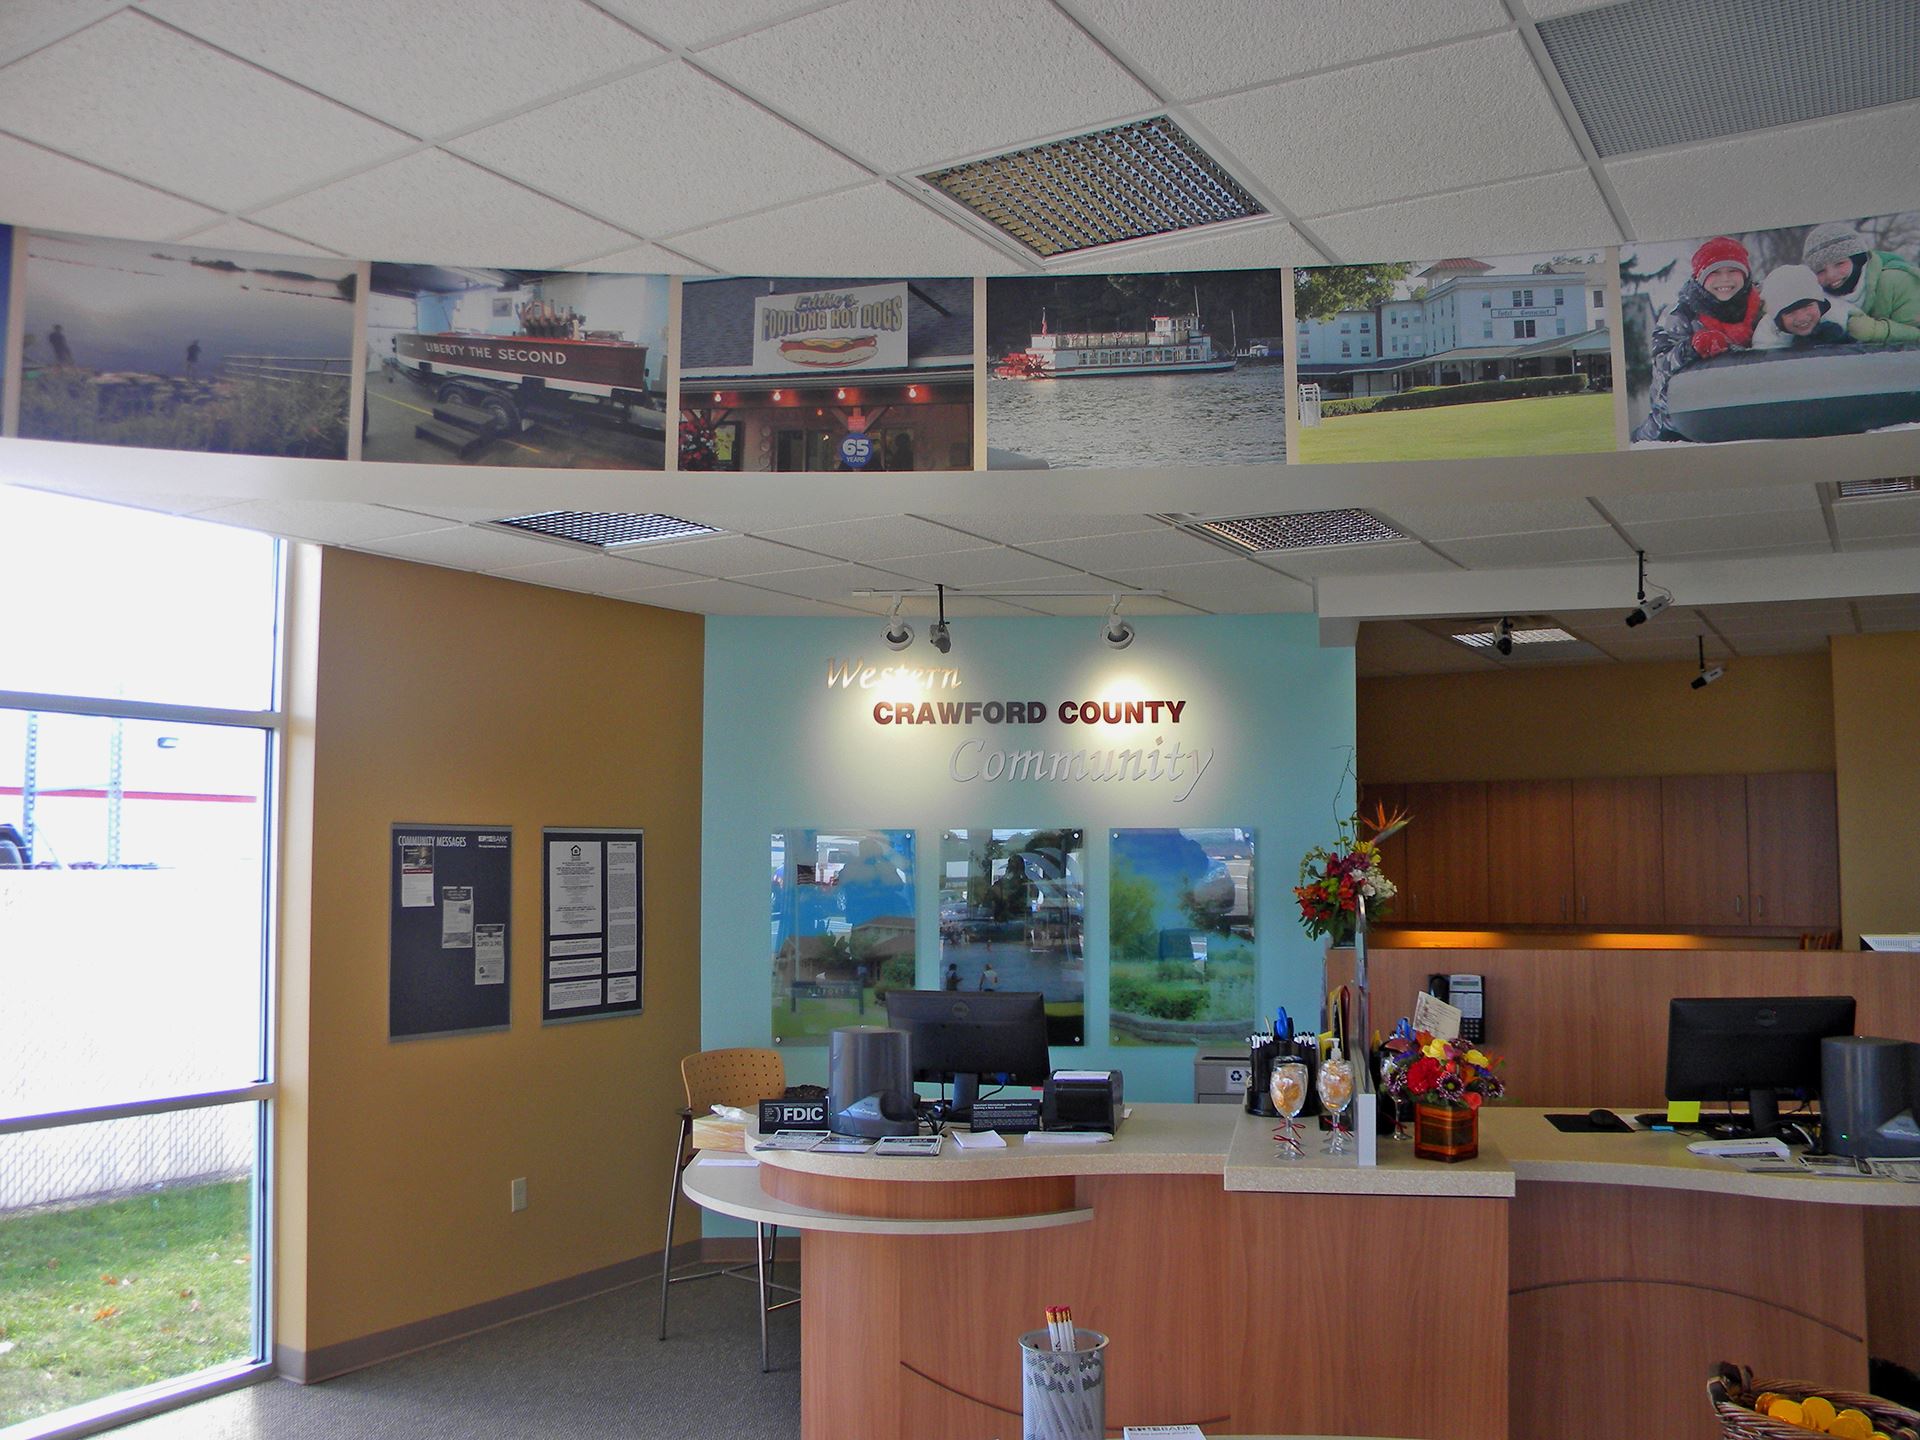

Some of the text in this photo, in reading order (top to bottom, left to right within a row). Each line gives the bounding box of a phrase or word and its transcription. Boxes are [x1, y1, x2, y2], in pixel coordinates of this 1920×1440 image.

[762, 295, 902, 341] FOOTLONG HOT DOGS
[424, 342, 567, 365] LIBERTY THE SECOND
[842, 438, 869, 456] 65
[846, 456, 866, 464] YEARS
[826, 656, 962, 689] Western
[873, 700, 1186, 725] CRAWFORD COUNTY
[949, 735, 1215, 803] Community
[436, 836, 467, 848] MESSAGES
[783, 1107, 824, 1121] FDIC
